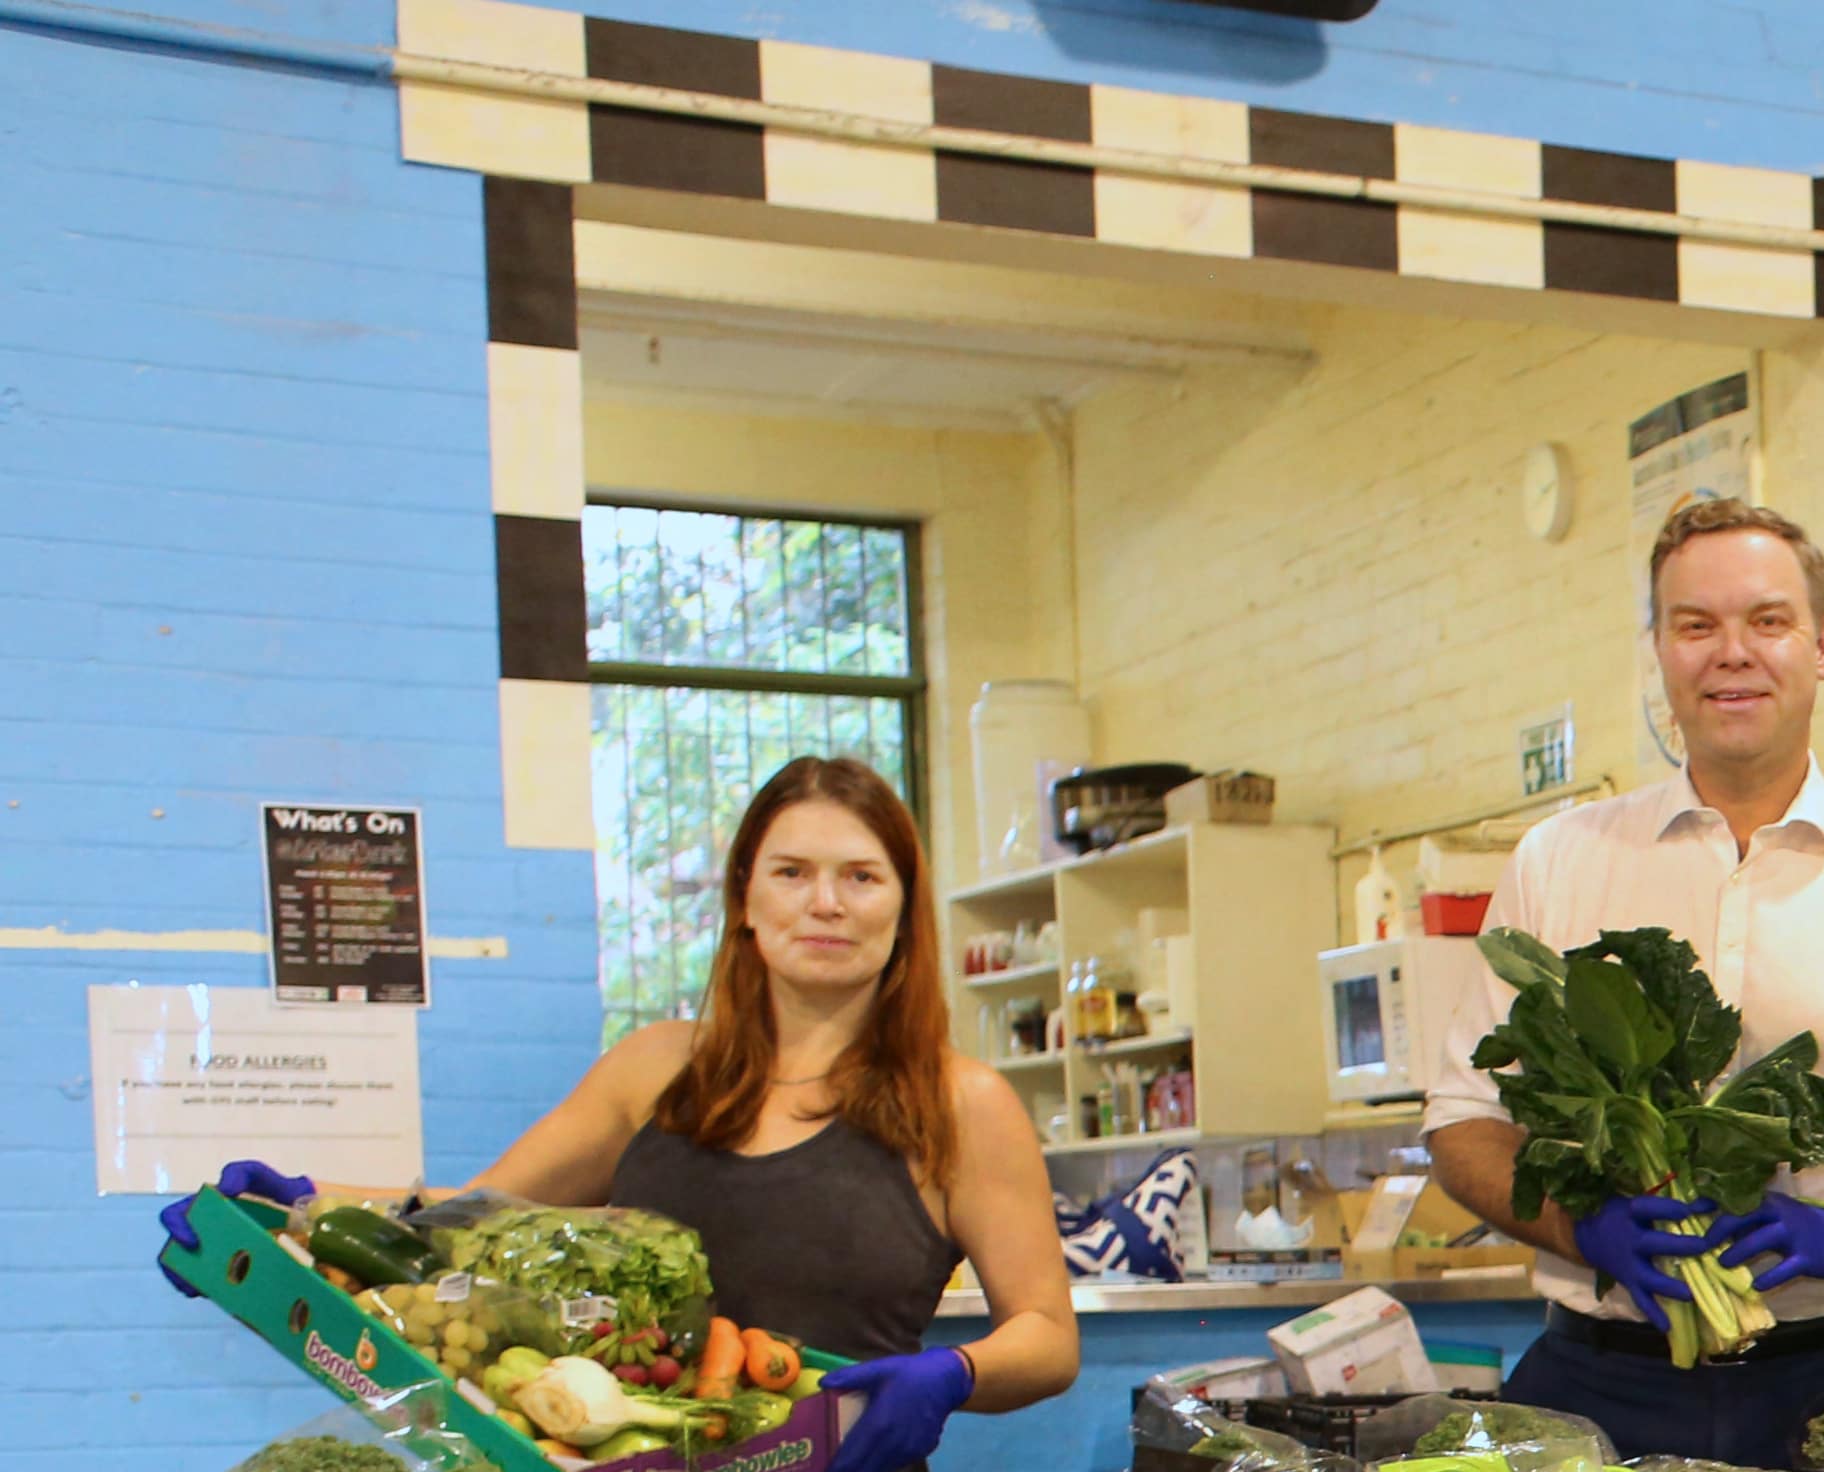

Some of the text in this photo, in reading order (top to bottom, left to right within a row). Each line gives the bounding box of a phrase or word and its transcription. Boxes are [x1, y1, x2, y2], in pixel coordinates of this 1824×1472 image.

[272, 809, 405, 834] What's On
[243, 1055, 327, 1070] ALLERGIES
